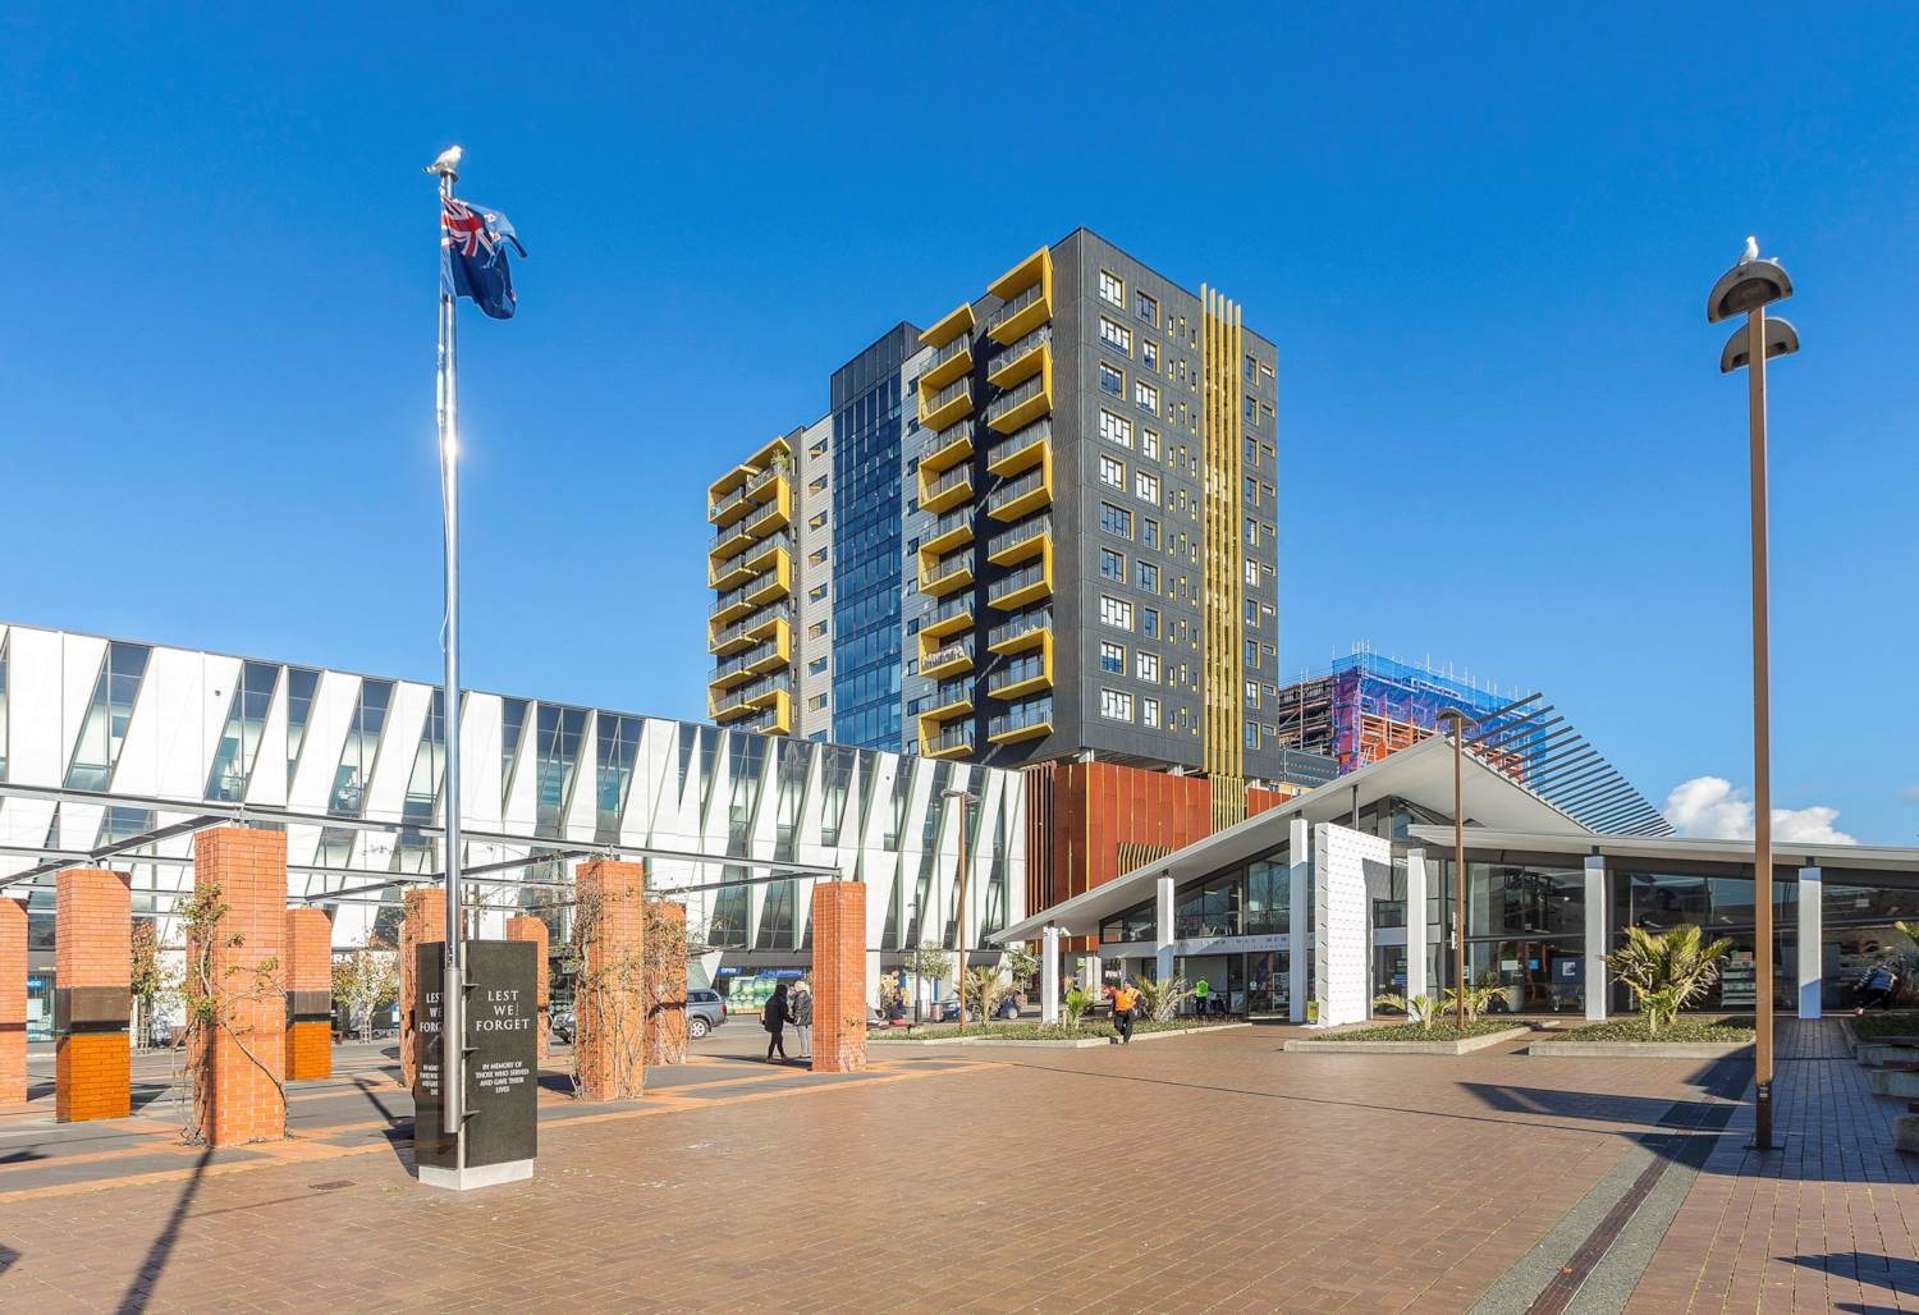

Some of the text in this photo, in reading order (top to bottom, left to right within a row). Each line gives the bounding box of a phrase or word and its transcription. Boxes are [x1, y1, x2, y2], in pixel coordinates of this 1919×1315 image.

[487, 990, 519, 1001] LEST
[493, 1004, 514, 1016] WE
[476, 1019, 530, 1031] FORGET
[508, 1076, 524, 1084] THEIR
